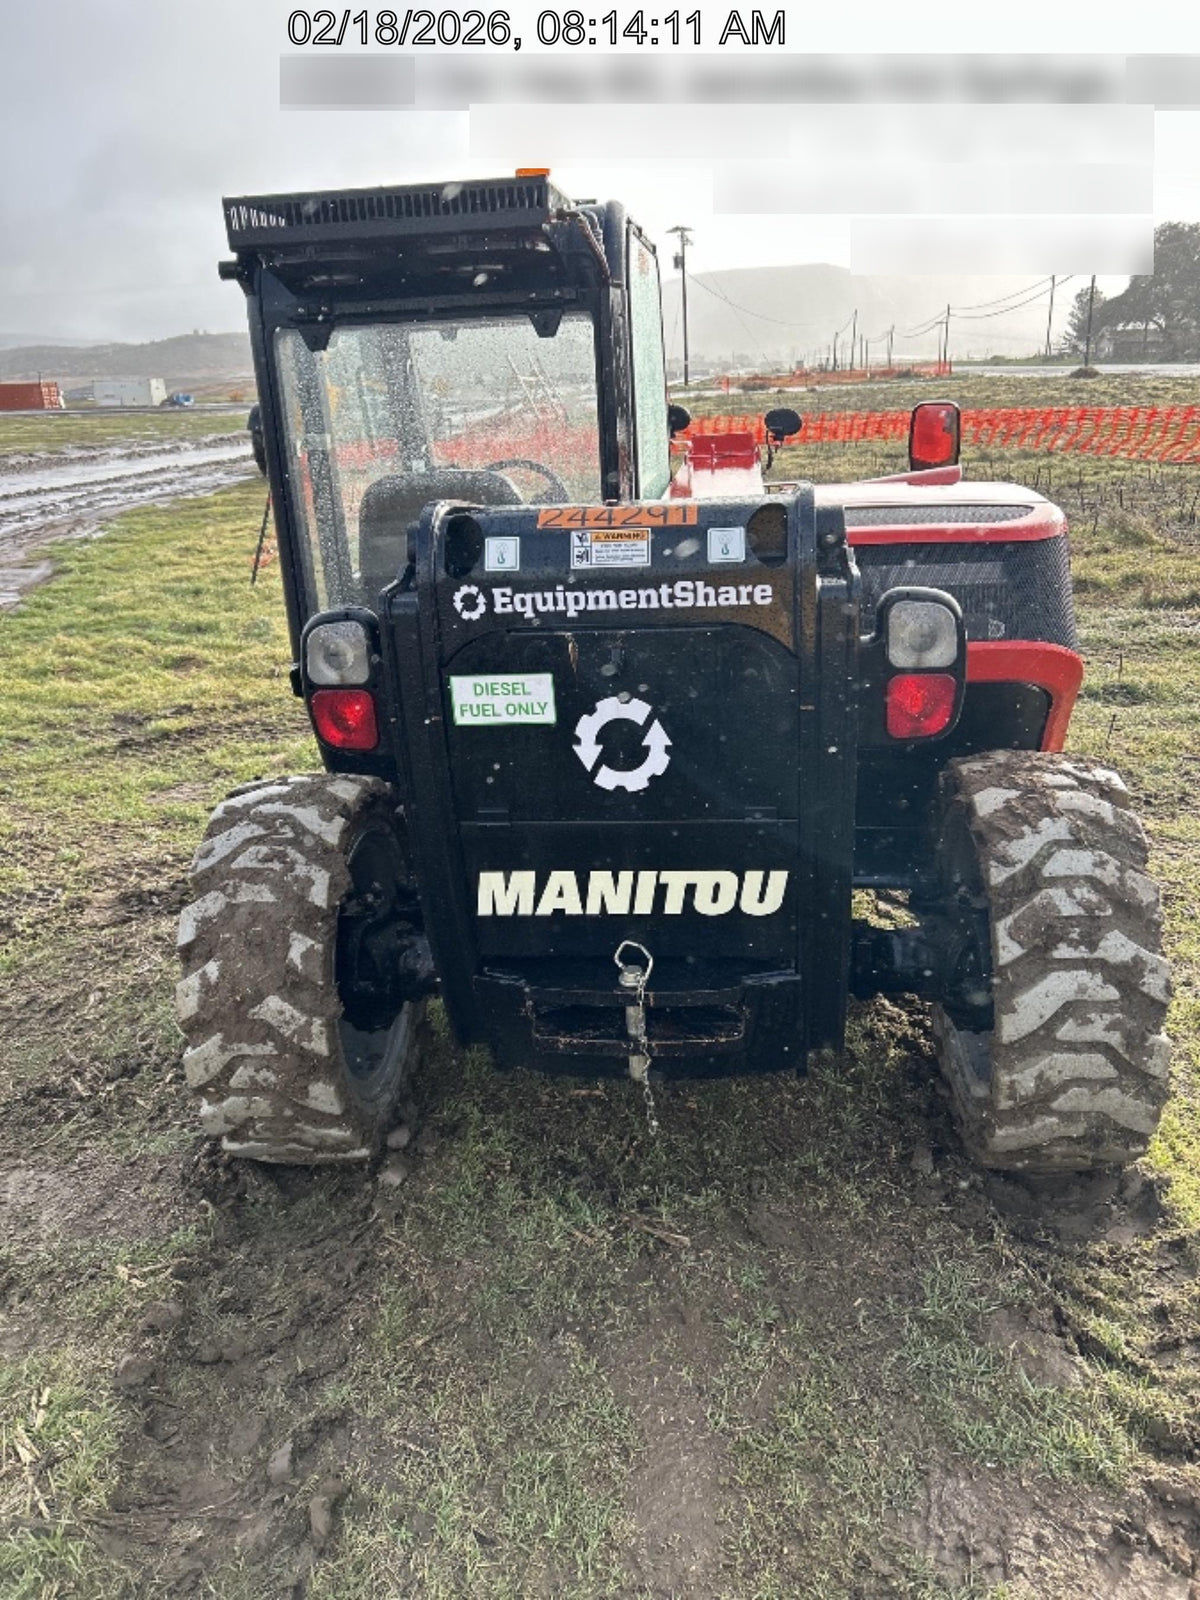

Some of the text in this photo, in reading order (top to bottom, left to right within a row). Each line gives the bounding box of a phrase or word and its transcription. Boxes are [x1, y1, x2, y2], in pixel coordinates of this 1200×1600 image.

[542, 504, 691, 527] 244291
[491, 581, 773, 618] EquipmentShare
[473, 682, 531, 696] DIESEL
[460, 702, 548, 717] FUEL ONLY
[477, 870, 789, 917] MANITOU
